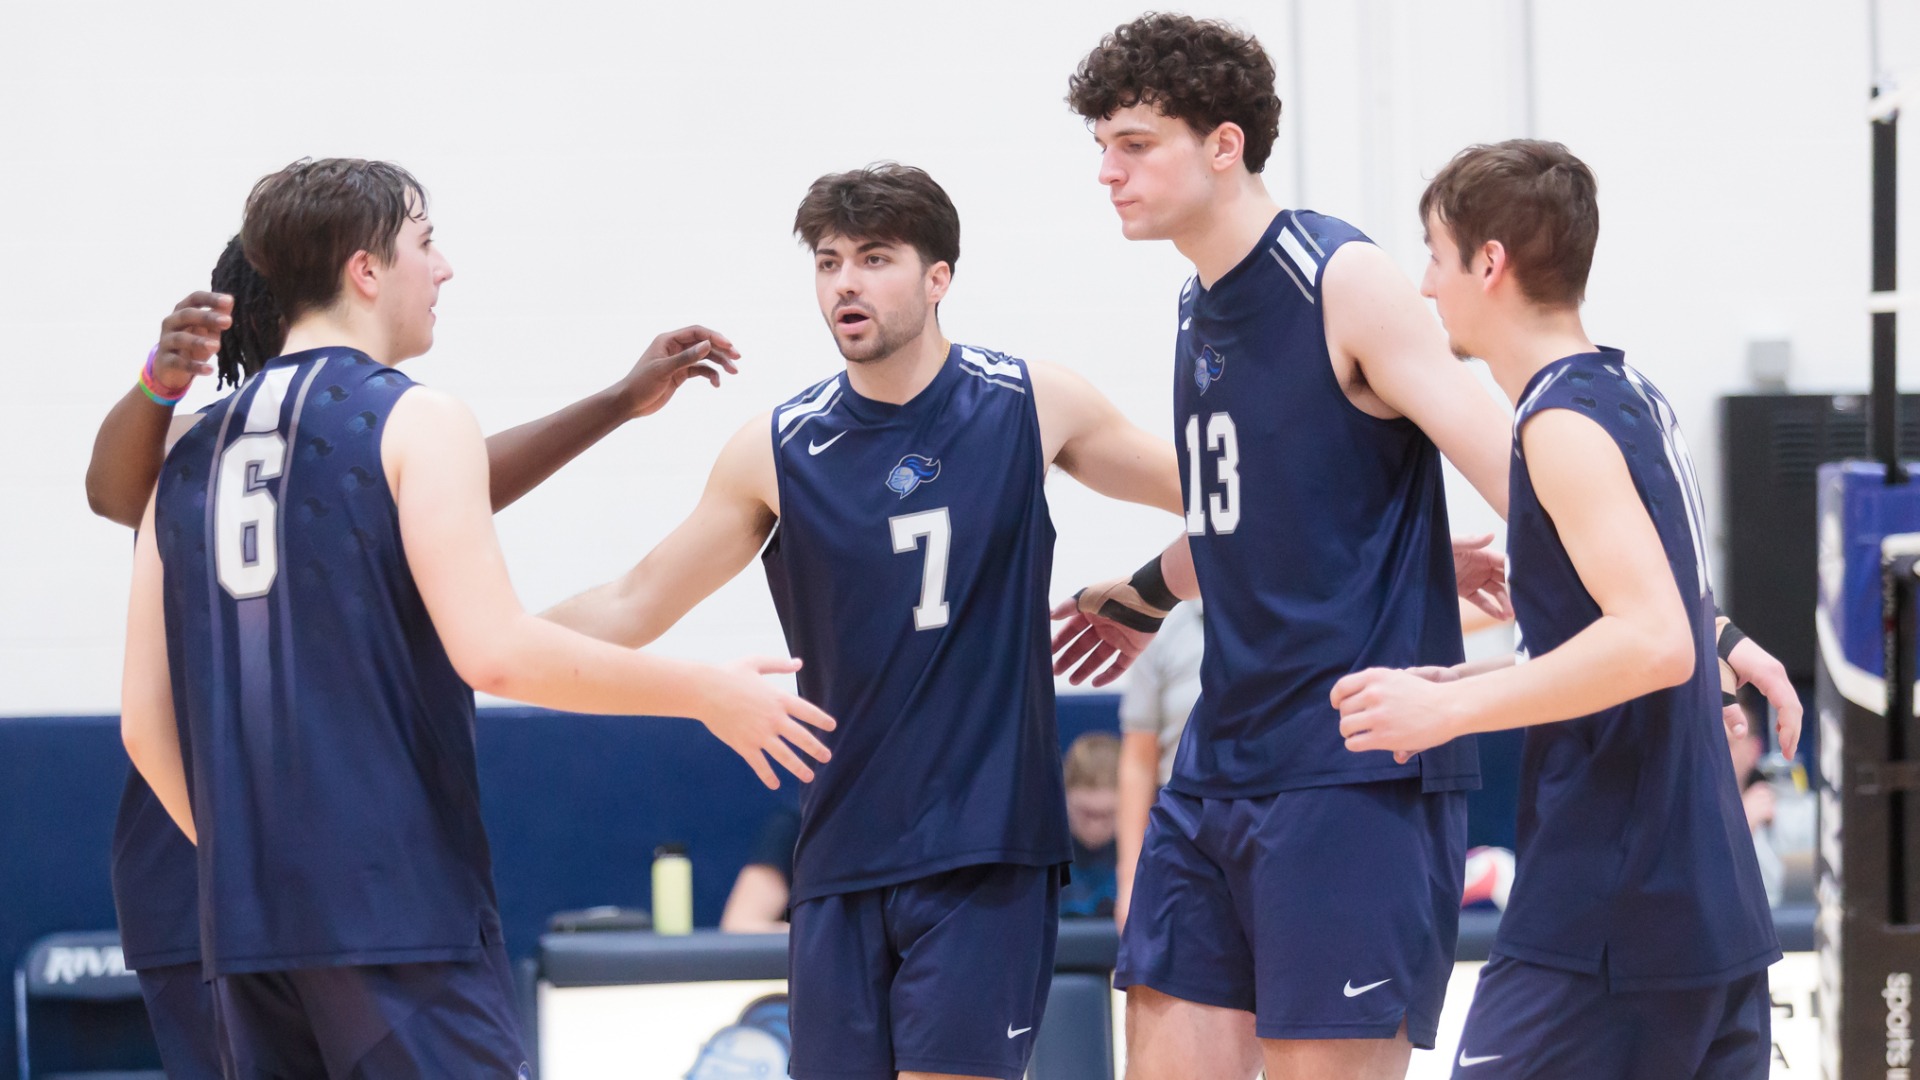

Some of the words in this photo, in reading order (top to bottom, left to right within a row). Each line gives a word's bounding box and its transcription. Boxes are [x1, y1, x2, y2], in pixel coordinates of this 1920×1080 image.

[214, 430, 287, 600] 6
[1185, 411, 1240, 536] 13
[888, 506, 952, 632] 7
[1881, 972, 1915, 1068] sports
